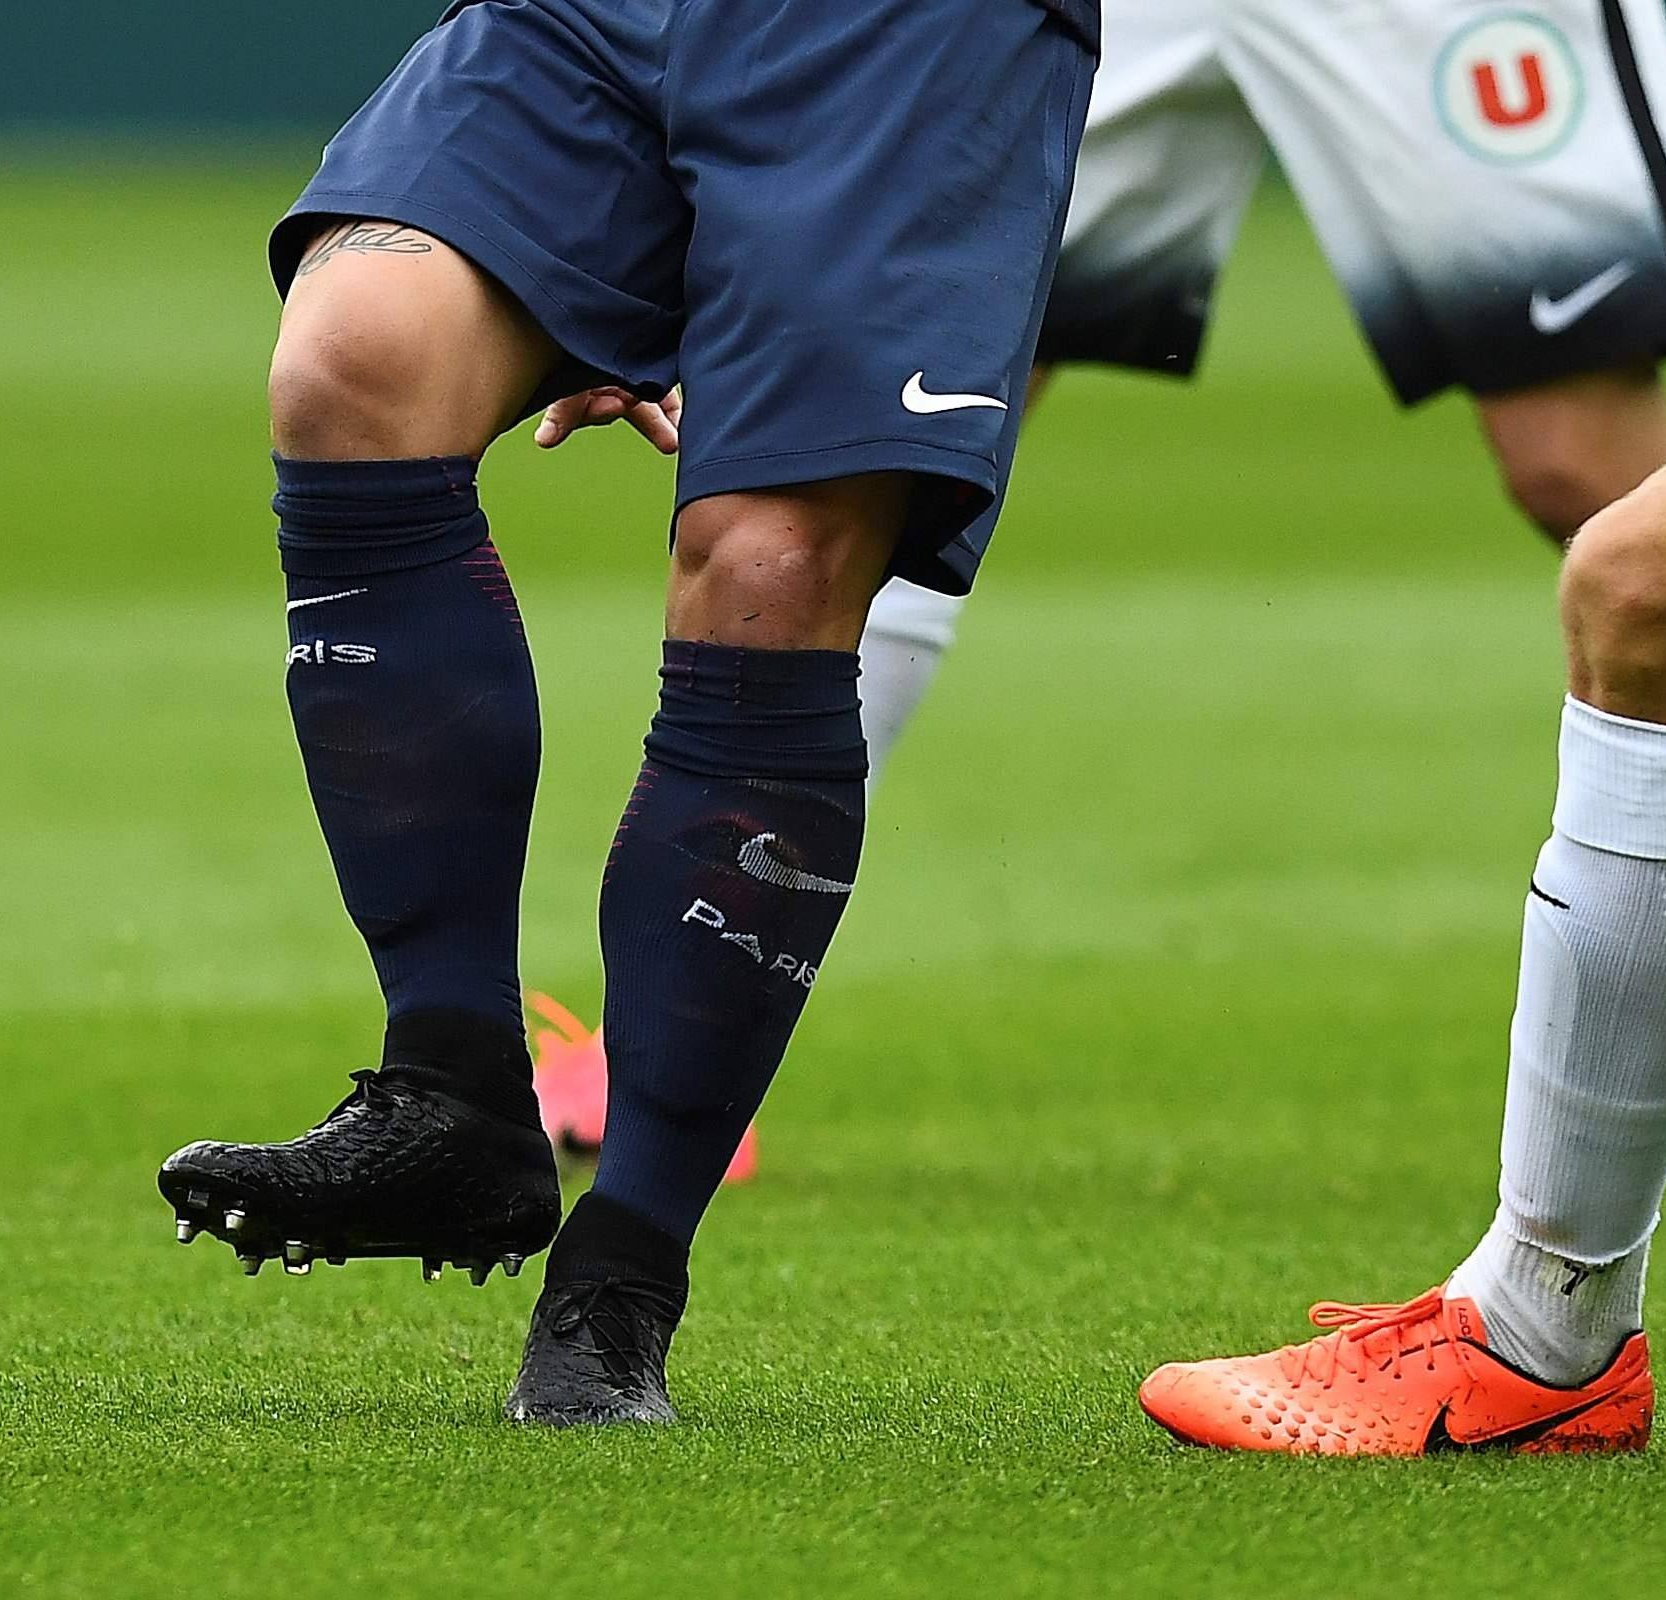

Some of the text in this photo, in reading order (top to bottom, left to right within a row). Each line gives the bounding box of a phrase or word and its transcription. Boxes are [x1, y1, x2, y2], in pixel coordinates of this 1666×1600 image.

[1472, 53, 1547, 127] U
[286, 639, 377, 665] RIS
[681, 897, 819, 988] PARIS
